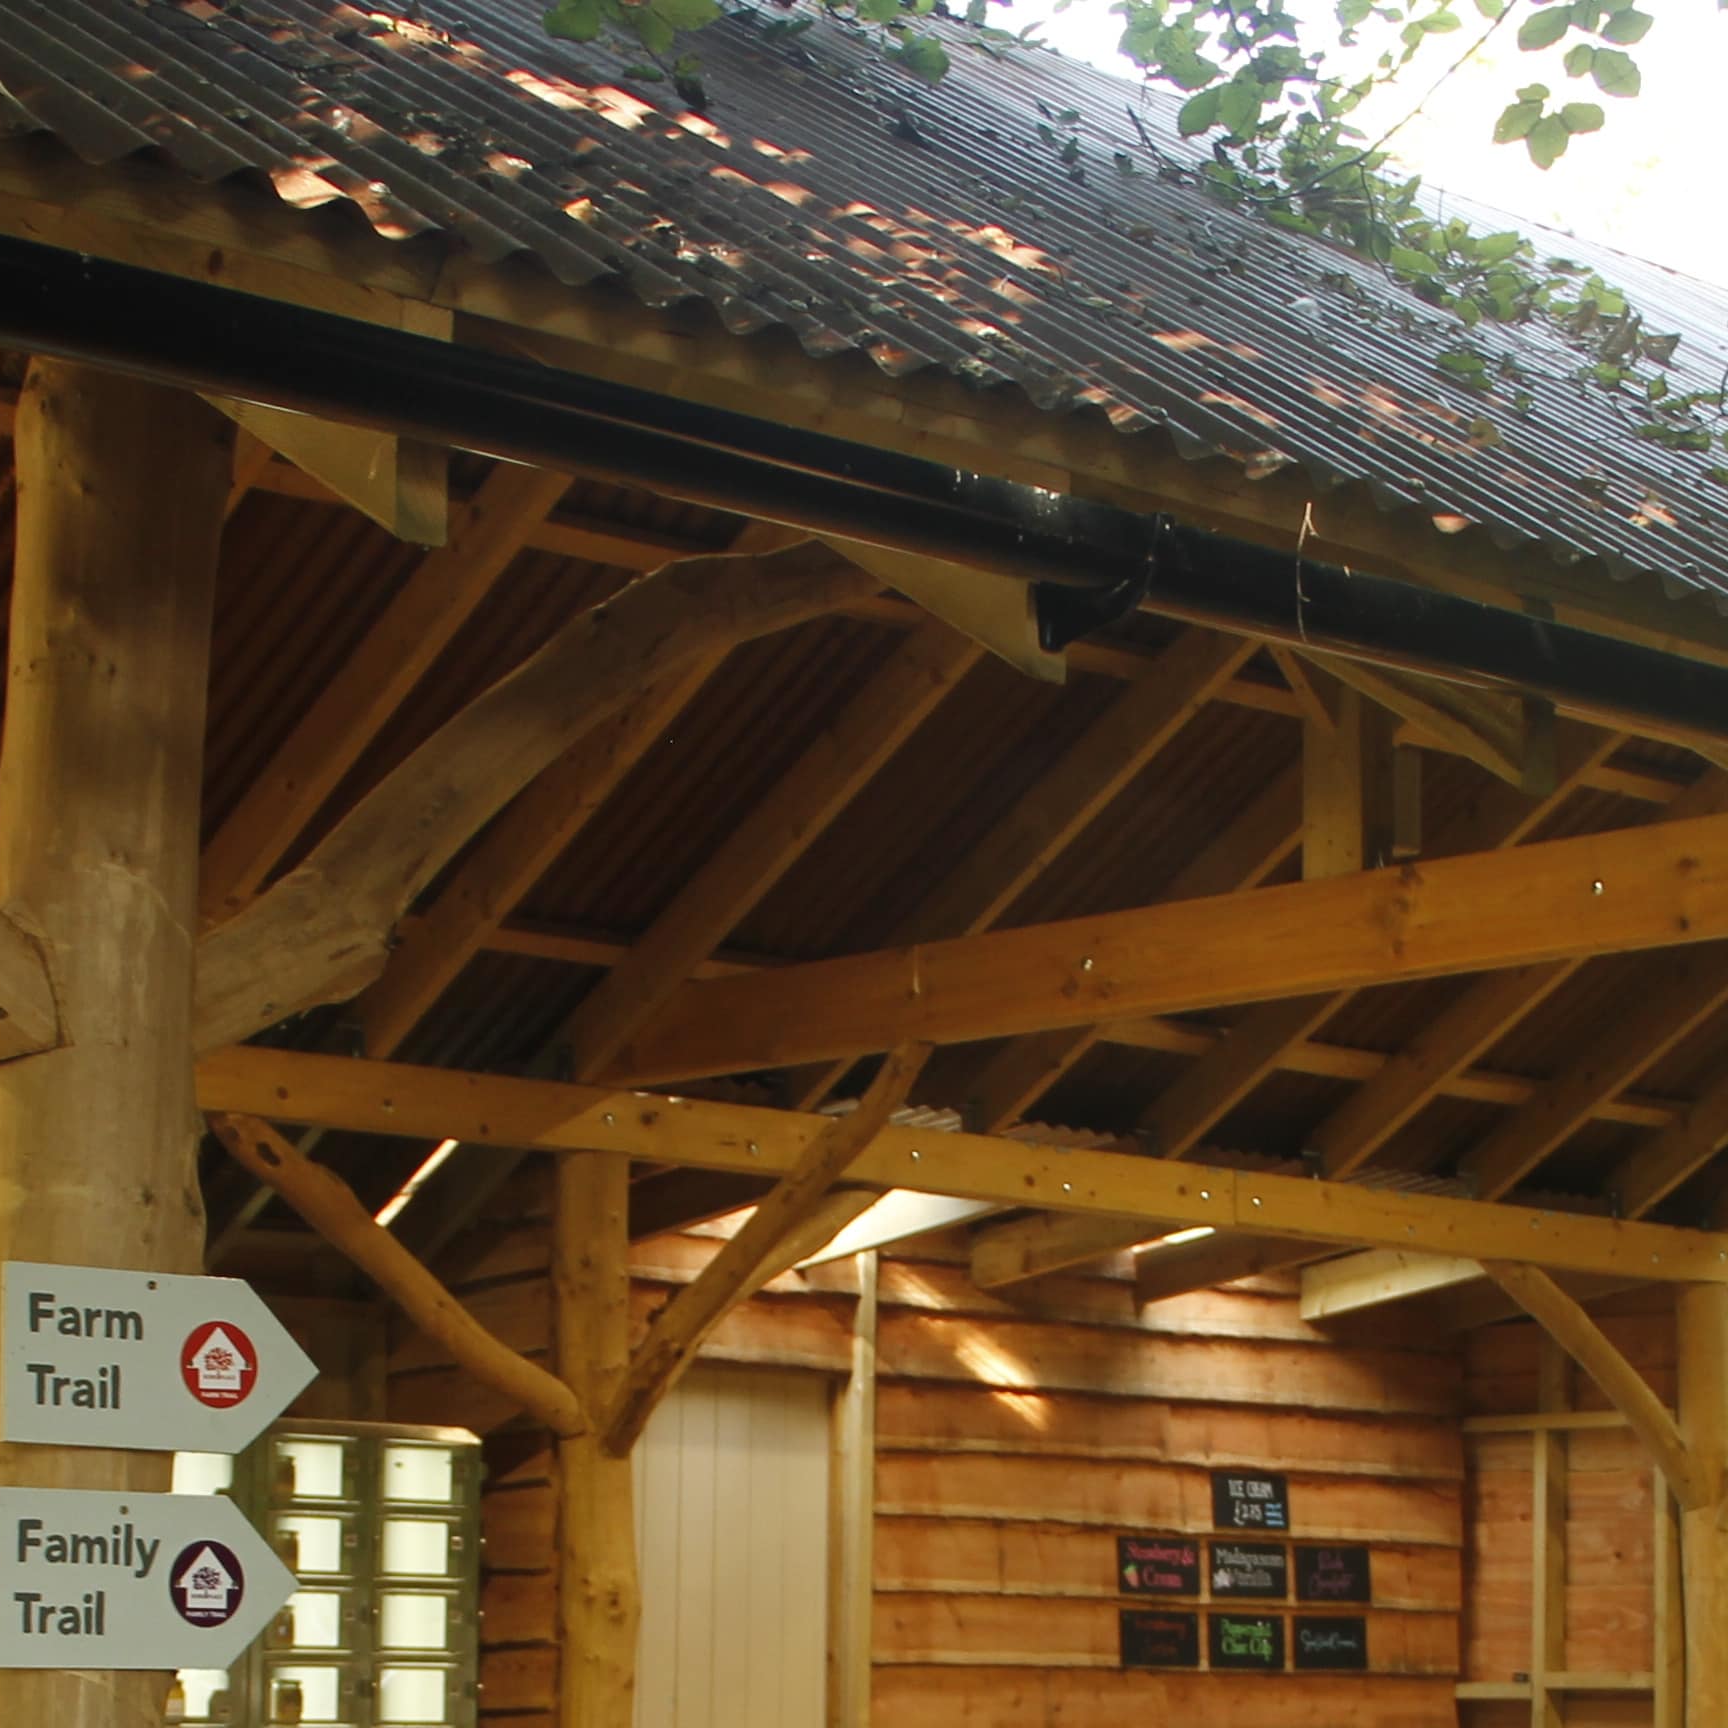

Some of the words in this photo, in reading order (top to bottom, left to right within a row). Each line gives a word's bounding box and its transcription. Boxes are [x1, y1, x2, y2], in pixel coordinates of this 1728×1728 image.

[27, 1291, 144, 1341] Farm
[26, 1363, 122, 1411] Trail
[16, 1518, 161, 1579] Family
[14, 1591, 106, 1637] Trail
